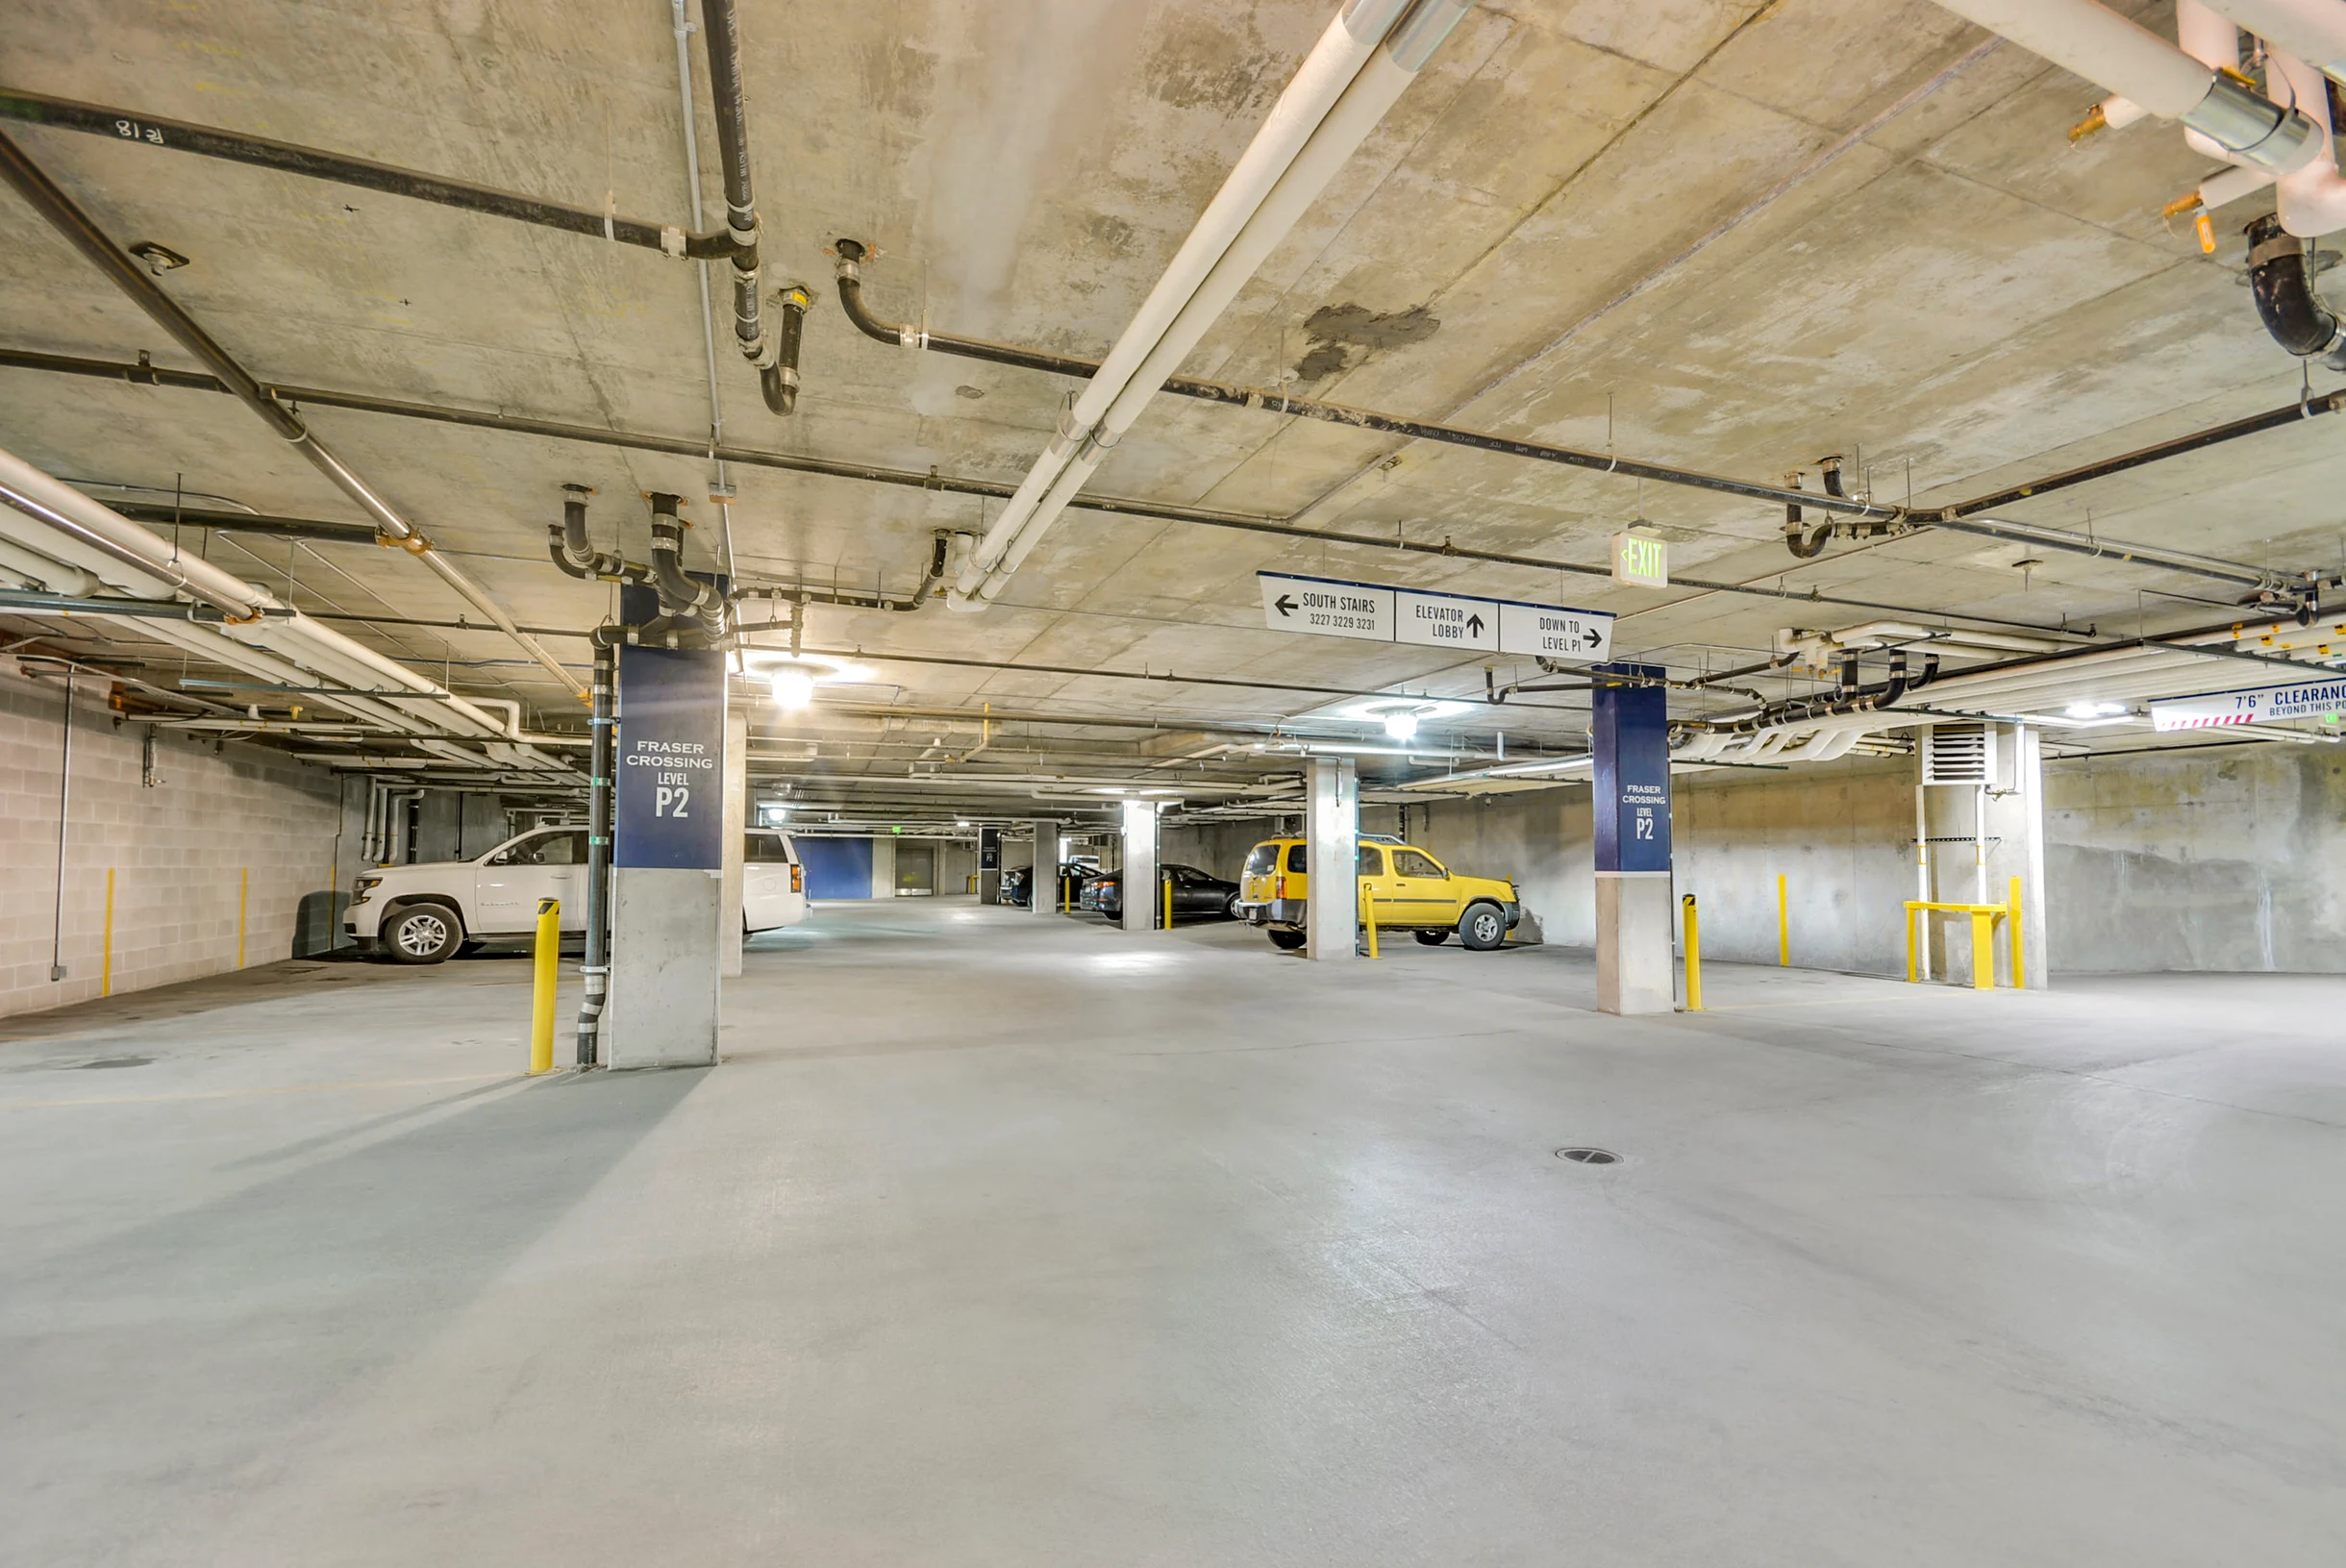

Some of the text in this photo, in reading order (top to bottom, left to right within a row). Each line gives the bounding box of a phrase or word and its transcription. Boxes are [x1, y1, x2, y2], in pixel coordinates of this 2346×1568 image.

[115, 120, 139, 138] 18
[1628, 538, 1661, 579] EXIT
[1303, 592, 1375, 613] SOUTH STAIRS
[1415, 605, 1463, 622] ELEVATOR
[1310, 613, 1375, 631] 3227 3229 3231
[1539, 617, 1580, 634] DOWN TO
[1433, 623, 1464, 639] LOBBY
[1542, 636, 1581, 652] LEVEL P1
[2269, 704, 2307, 716] BEYOND
[2309, 701, 2332, 712] THIS
[636, 740, 705, 755] FRASER
[626, 755, 713, 769] CROSSING
[658, 772, 689, 785] LEVEL
[1627, 784, 1660, 793] FRASER
[656, 786, 689, 817] P2
[1622, 795, 1666, 804] CROSSING
[1636, 808, 1653, 817] LEVEL
[1636, 818, 1654, 839] P2
